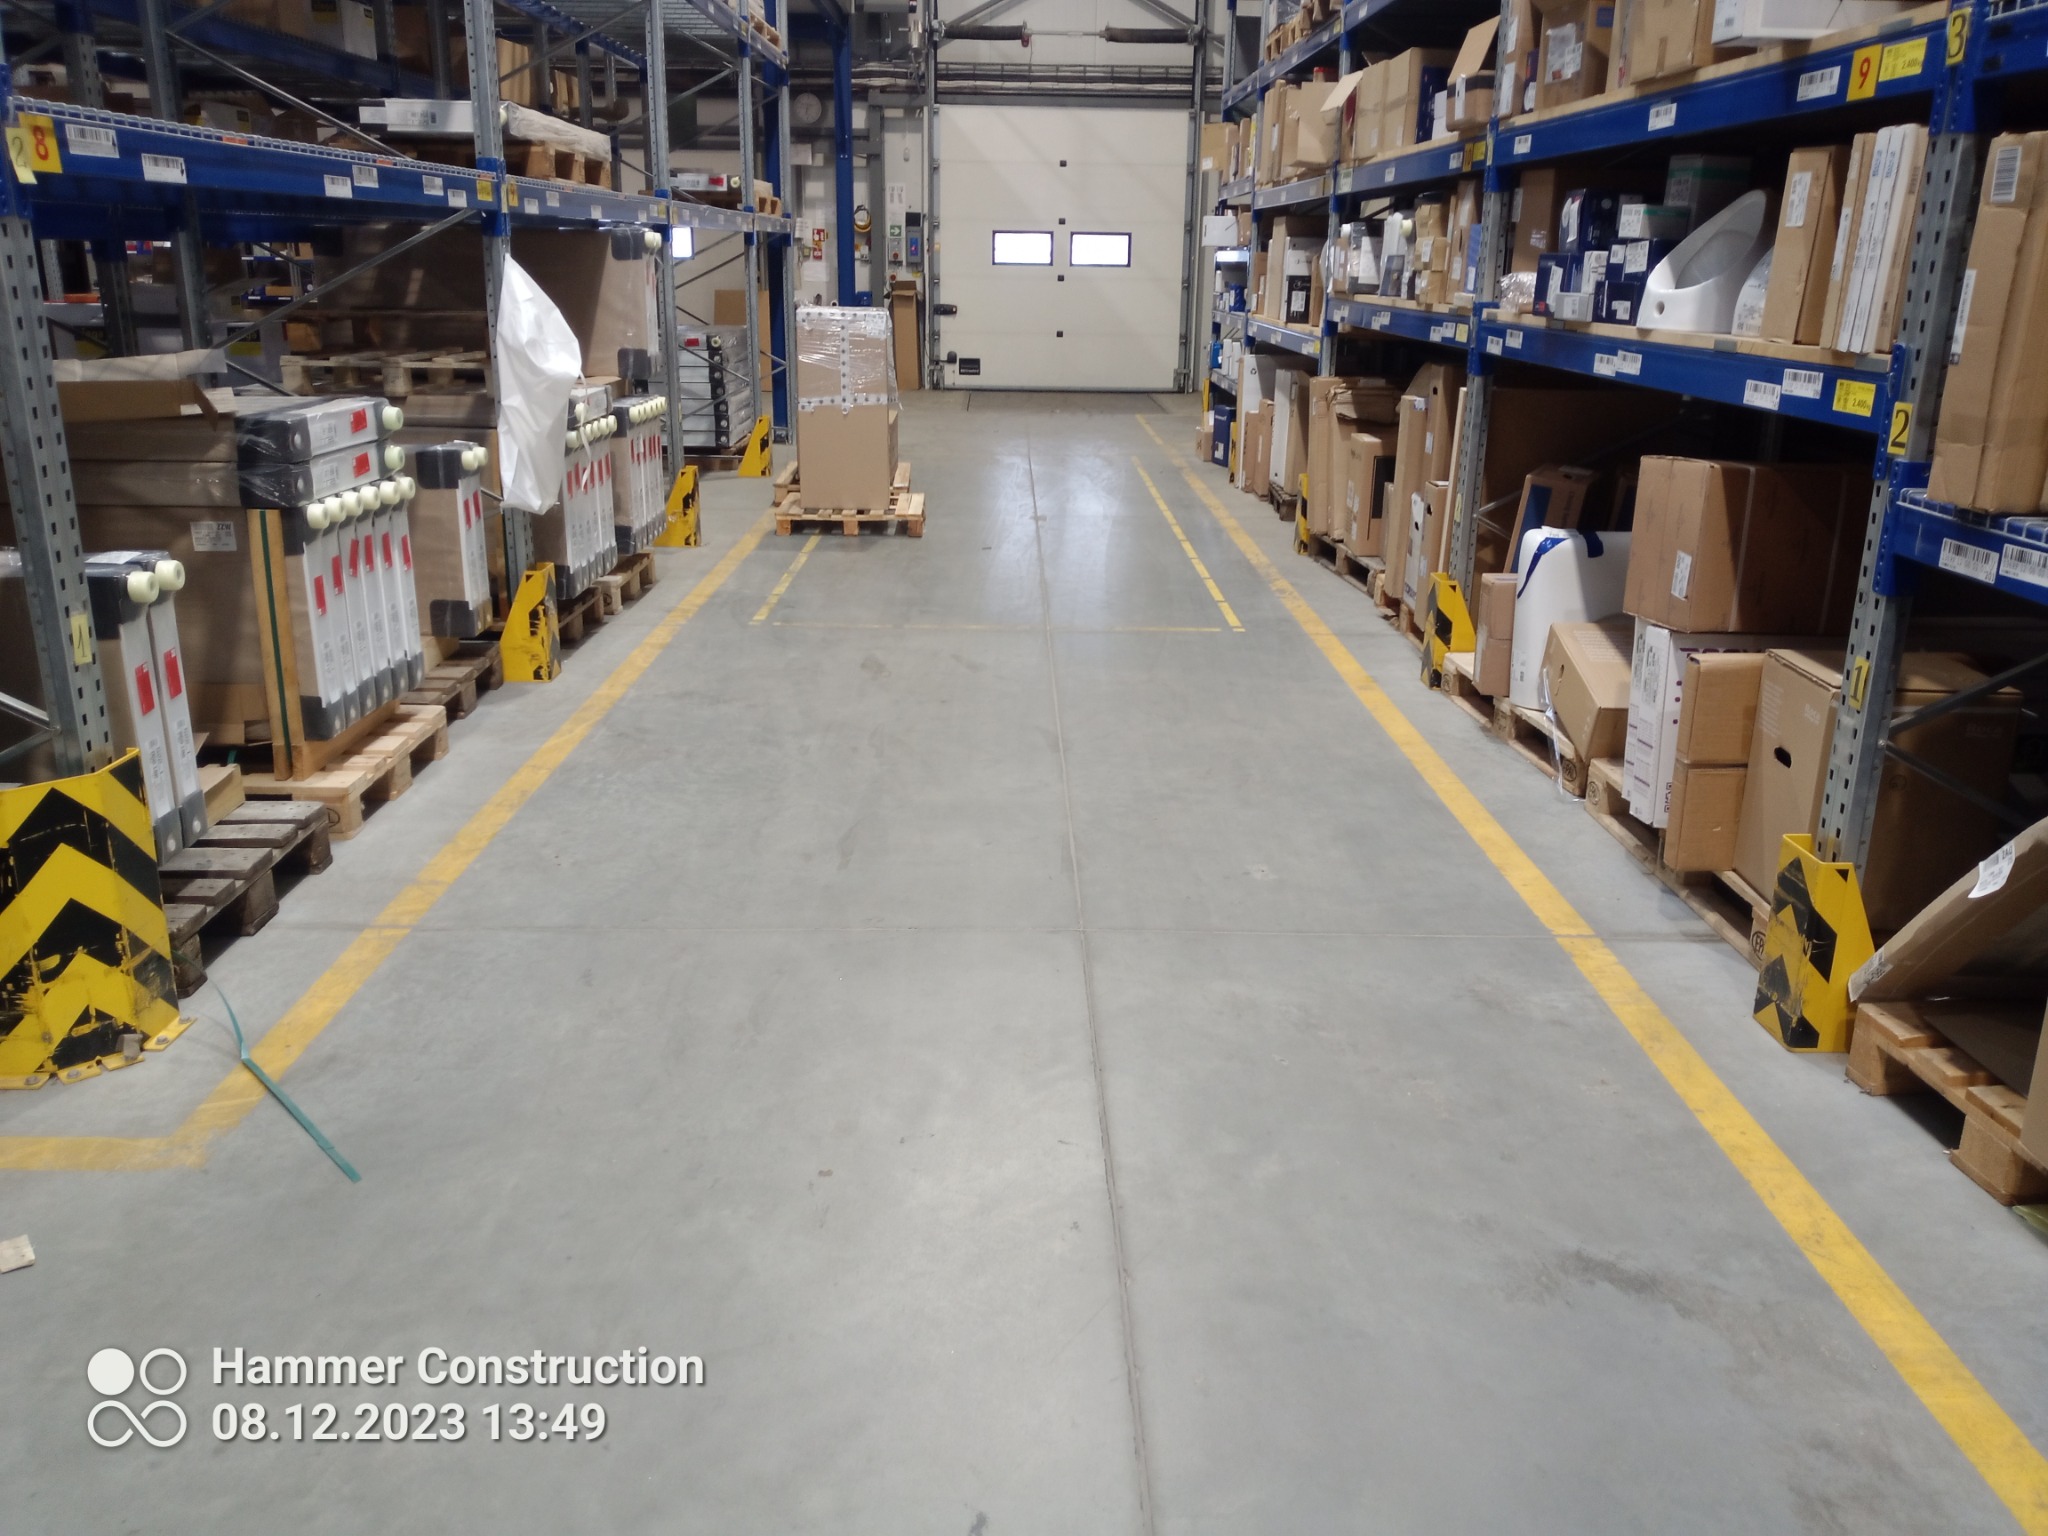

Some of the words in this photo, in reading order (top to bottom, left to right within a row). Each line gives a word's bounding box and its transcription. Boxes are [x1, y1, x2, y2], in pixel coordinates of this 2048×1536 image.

[1948, 13, 1967, 58] 3
[1859, 57, 1871, 90] 9
[12, 136, 27, 168] 2
[33, 125, 49, 161] 8
[1890, 409, 1910, 449] 2
[78, 624, 88, 658] 1
[1850, 665, 1863, 703] 1
